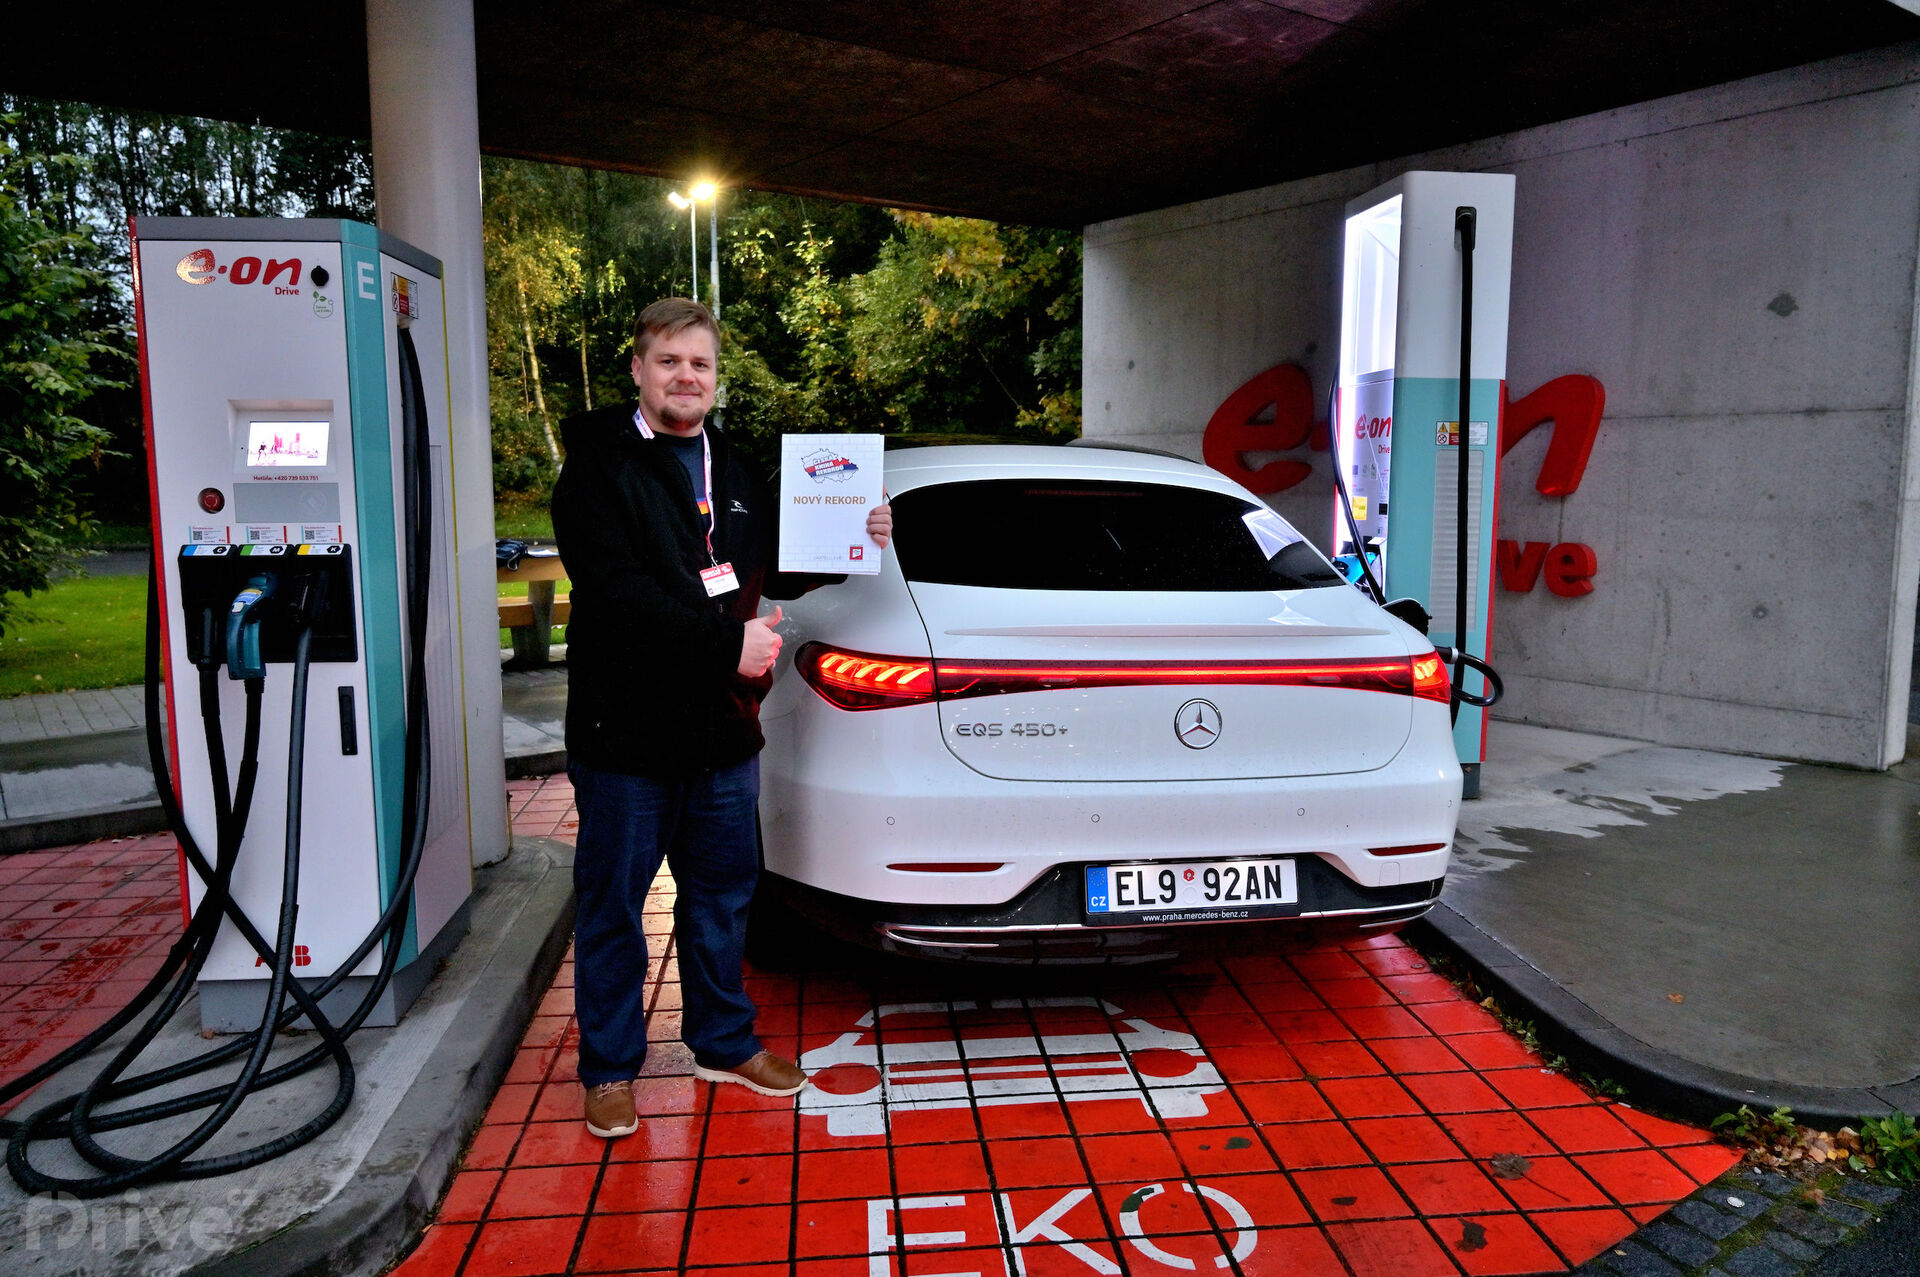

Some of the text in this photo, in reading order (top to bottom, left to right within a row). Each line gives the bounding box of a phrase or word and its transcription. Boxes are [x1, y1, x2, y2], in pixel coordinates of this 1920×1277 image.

[357, 261, 376, 300] E
[275, 287, 300, 296] Drive
[1378, 444, 1390, 454] Drive
[793, 494, 866, 505] NOVÝ REKORD
[956, 723, 1068, 737] EQS 450+
[1116, 865, 1283, 906] EL9 92AN
[1091, 896, 1107, 907] CZ
[1142, 911, 1249, 922] www.praha.mercedes-benz.cz
[867, 1183, 1258, 1277] EKO
